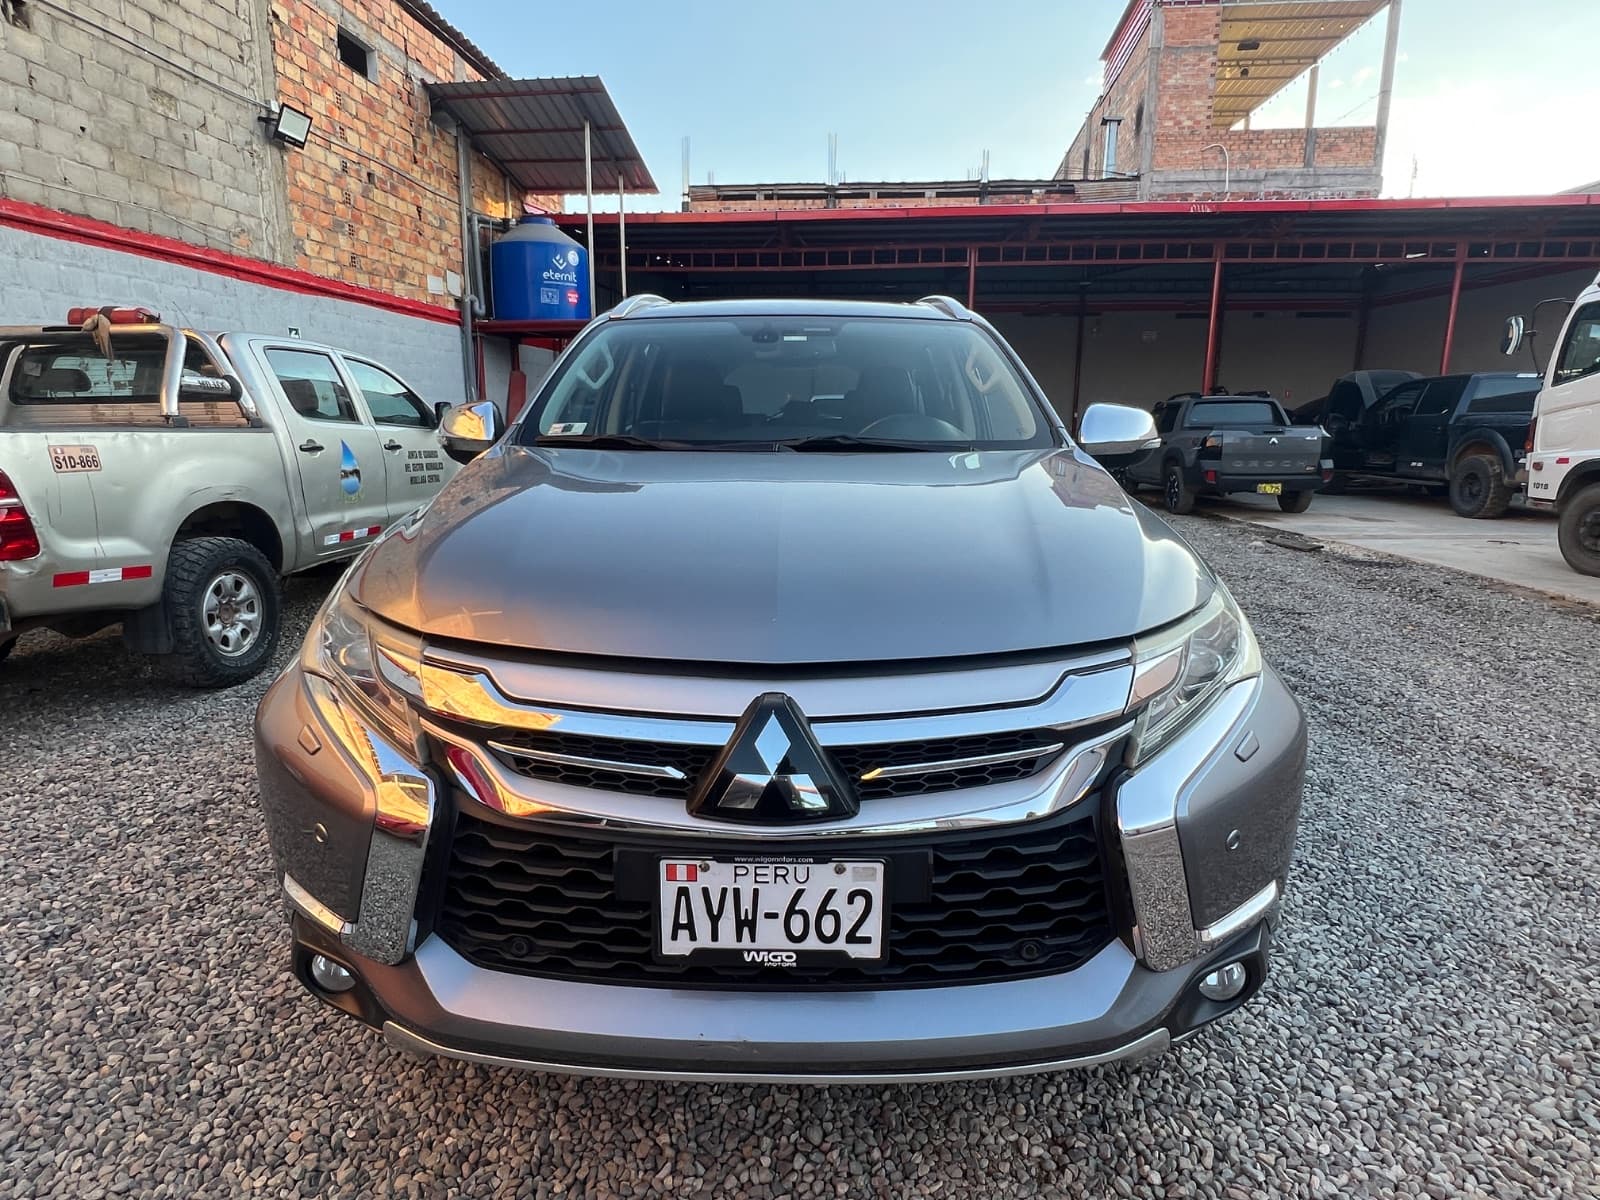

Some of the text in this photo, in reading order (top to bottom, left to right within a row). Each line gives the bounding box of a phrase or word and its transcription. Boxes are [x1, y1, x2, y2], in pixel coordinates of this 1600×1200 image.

[542, 269, 577, 282] eternit
[54, 455, 99, 470] S1D-866
[734, 865, 810, 884] PERU
[671, 886, 873, 944] AYW-662
